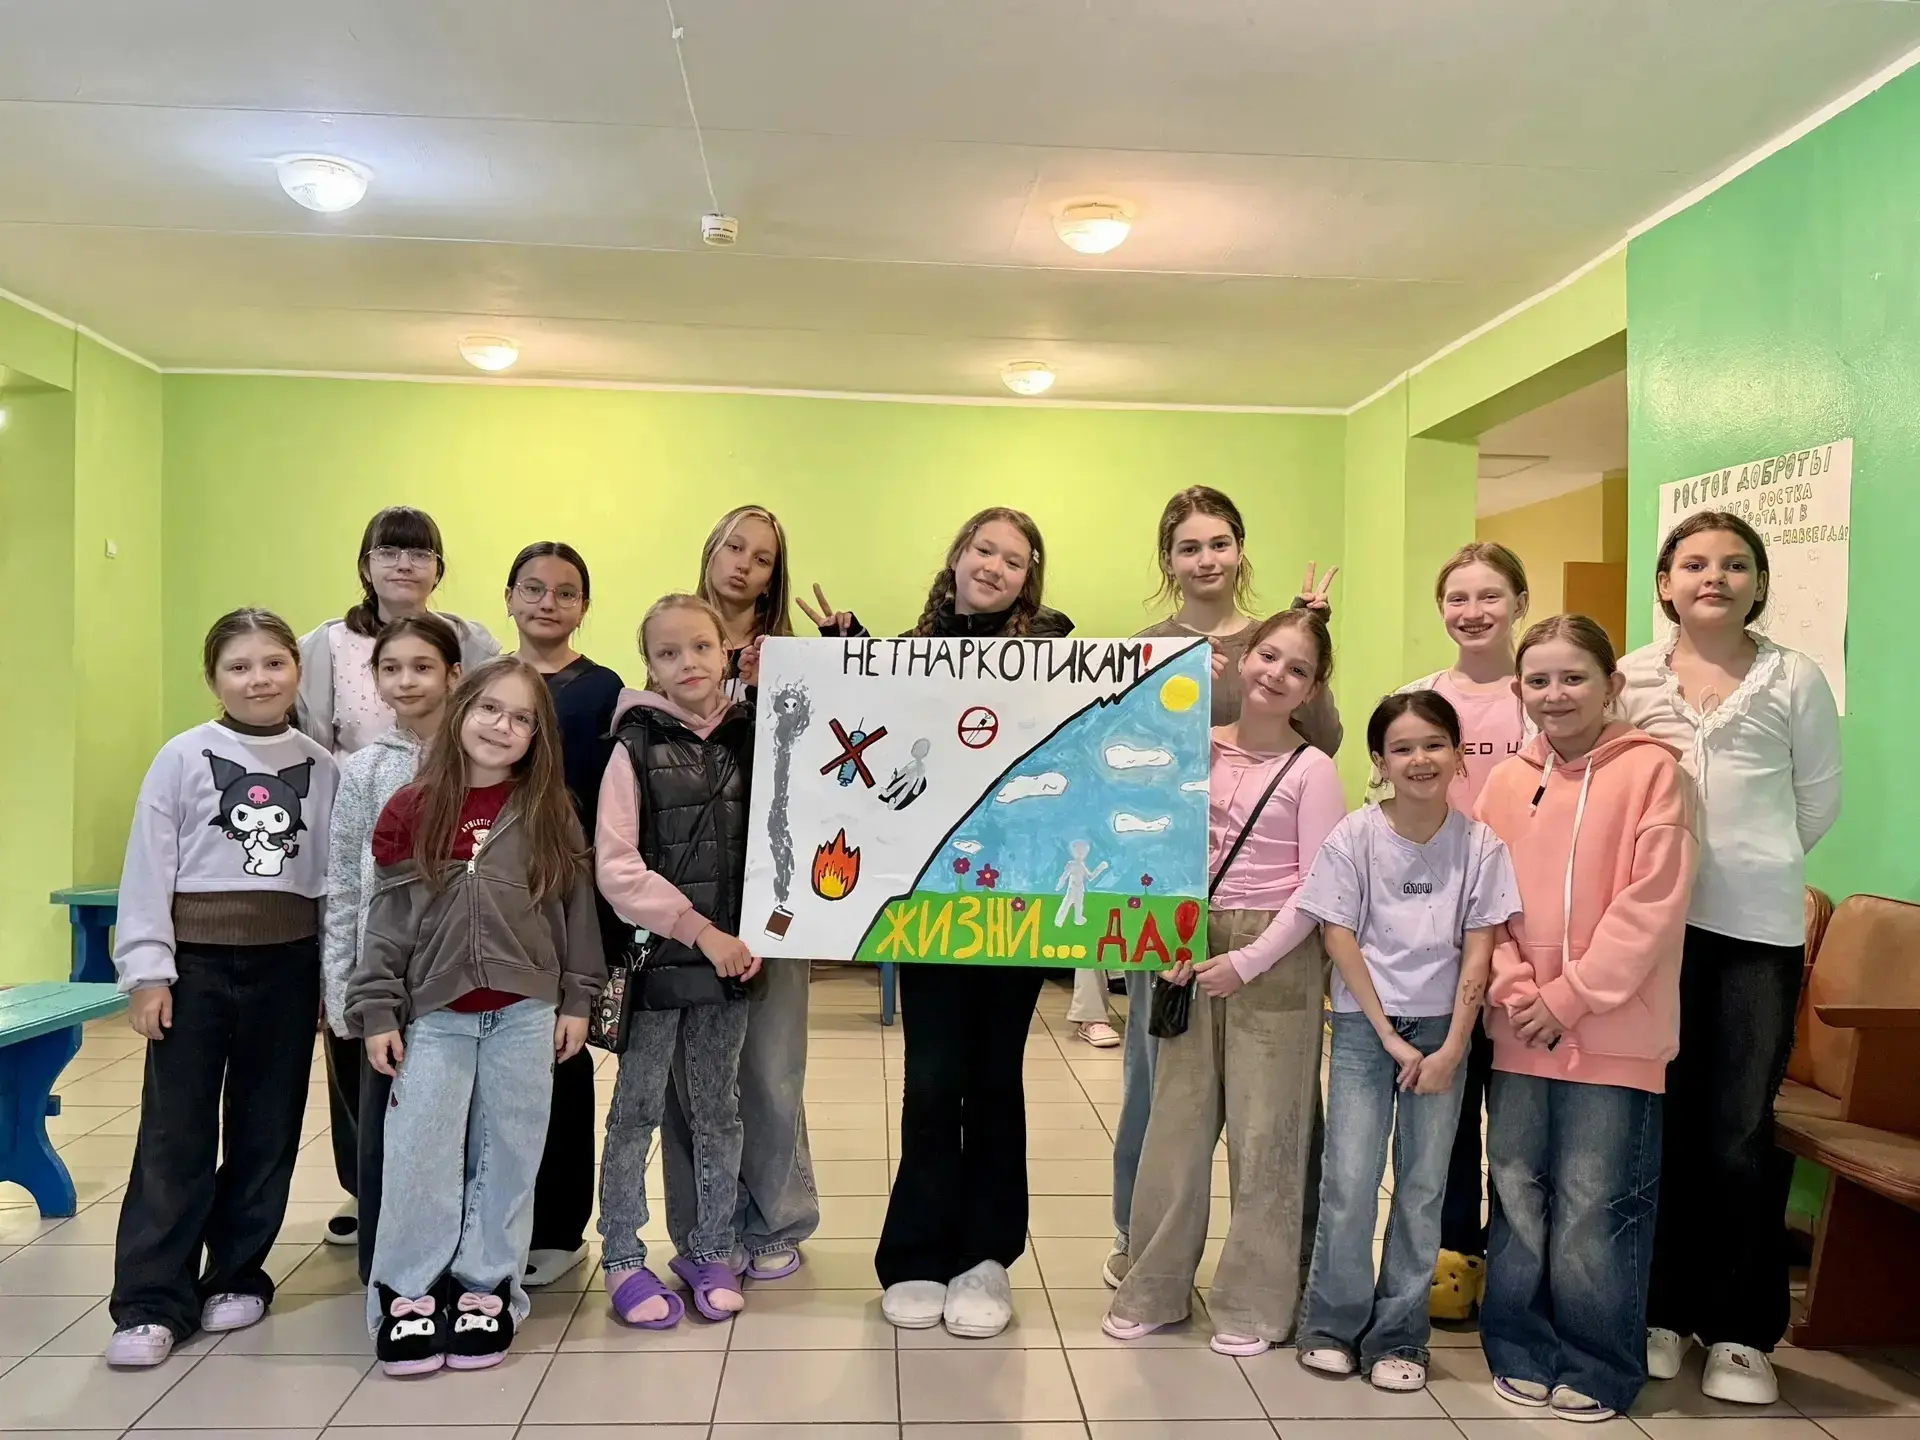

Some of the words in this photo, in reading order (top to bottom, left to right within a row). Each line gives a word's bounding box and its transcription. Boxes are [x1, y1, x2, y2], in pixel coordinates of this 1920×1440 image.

[1673, 470, 1731, 514] РОСТОК
[1736, 446, 1832, 493] ДОБРОТЫ
[1758, 482, 1813, 511] РОСТКА
[461, 818, 492, 833] ATHLETIC
[1096, 899, 1201, 964] ДА!
